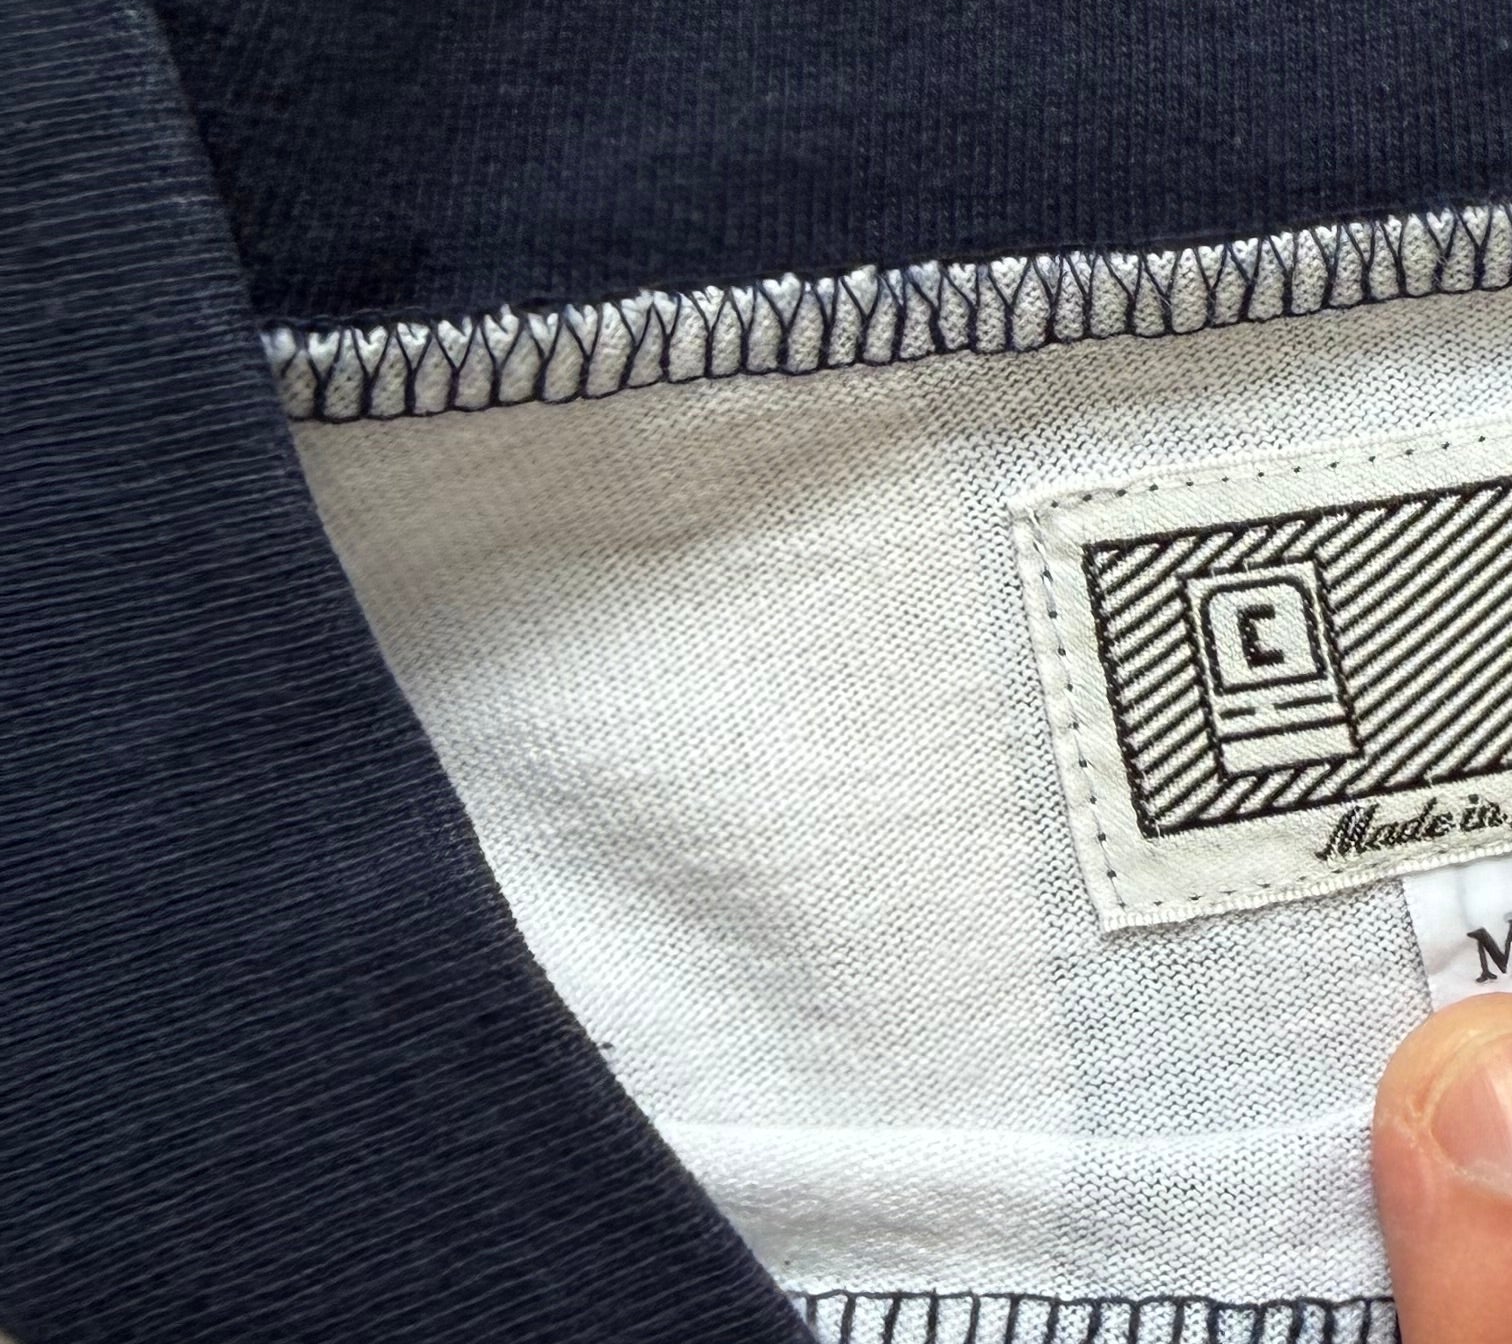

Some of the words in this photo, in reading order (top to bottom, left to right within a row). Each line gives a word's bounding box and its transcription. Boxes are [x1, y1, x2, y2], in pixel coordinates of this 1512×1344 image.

[1237, 604, 1285, 669] C
[1315, 796, 1456, 860] Made
[1459, 794, 1508, 832] in
